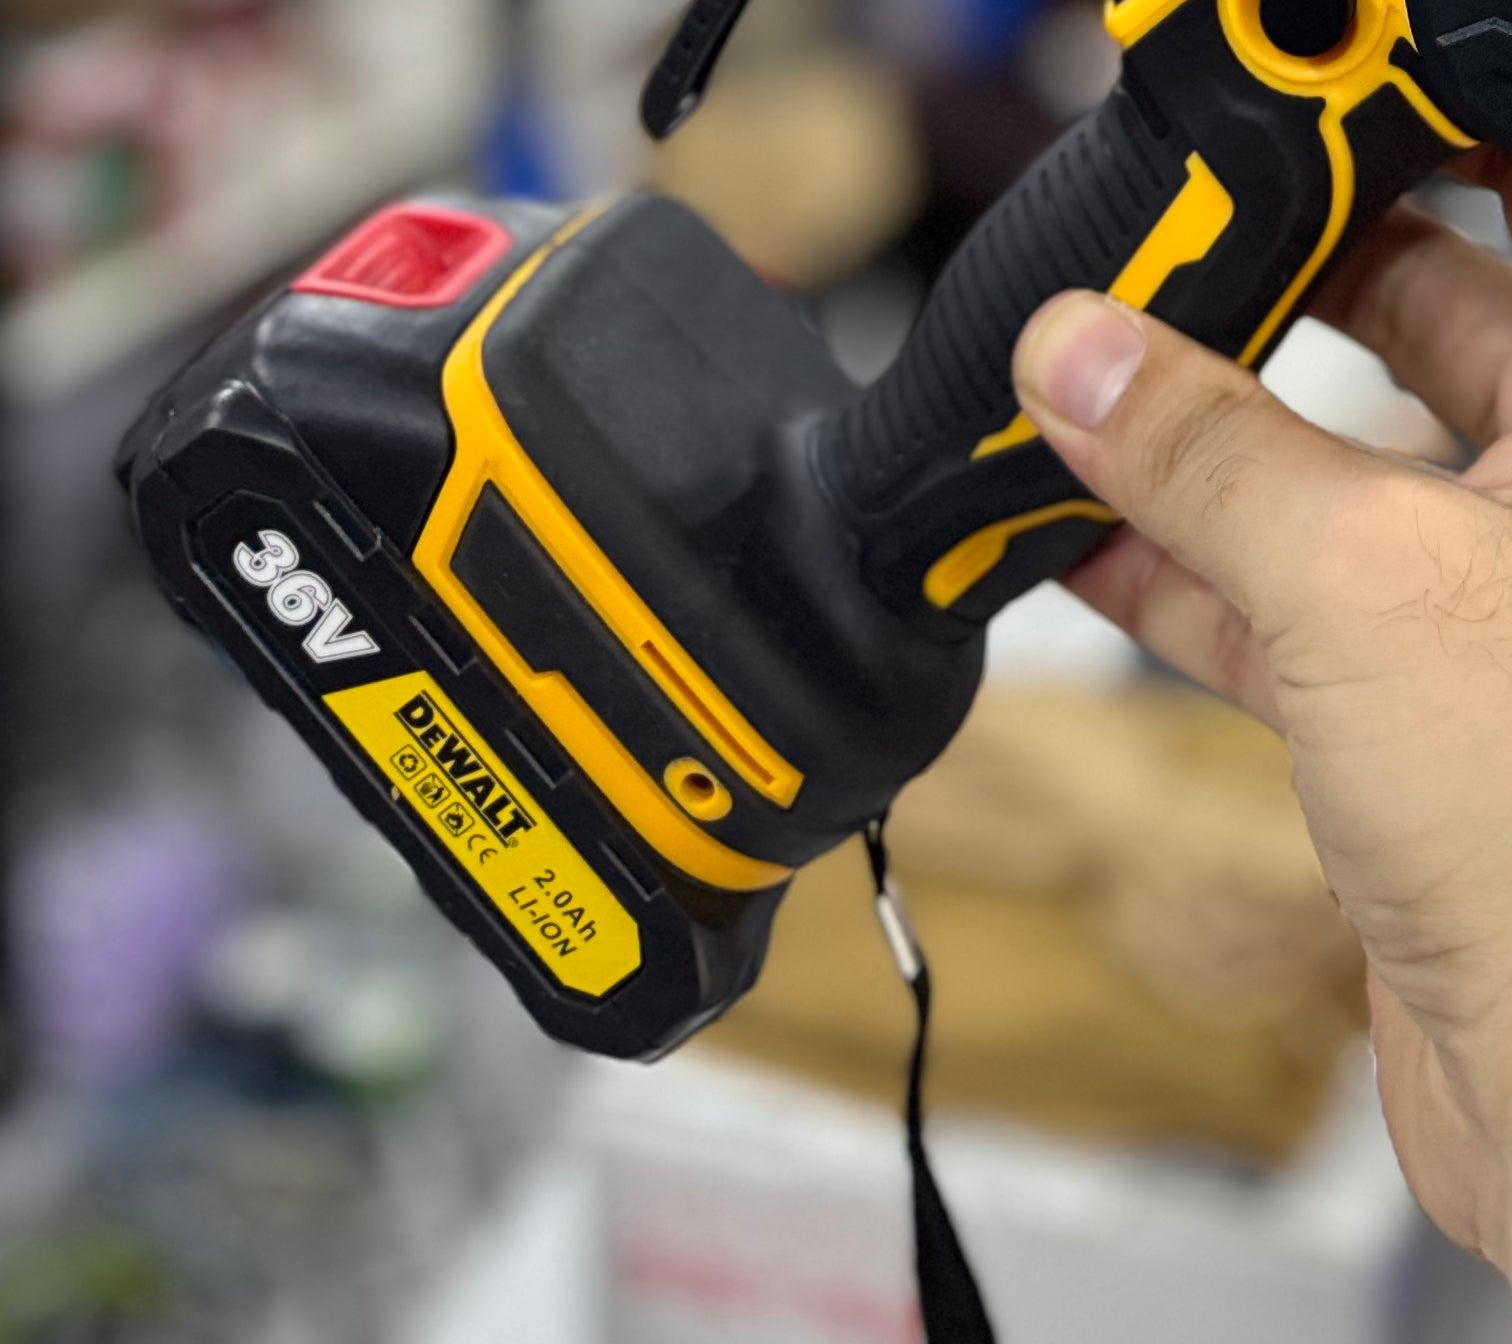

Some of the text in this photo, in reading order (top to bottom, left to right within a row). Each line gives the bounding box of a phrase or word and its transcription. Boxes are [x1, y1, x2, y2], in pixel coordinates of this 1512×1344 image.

[233, 529, 381, 664] 36V
[508, 885, 577, 958] LI-ION
[533, 868, 598, 943] 2.0Ah
